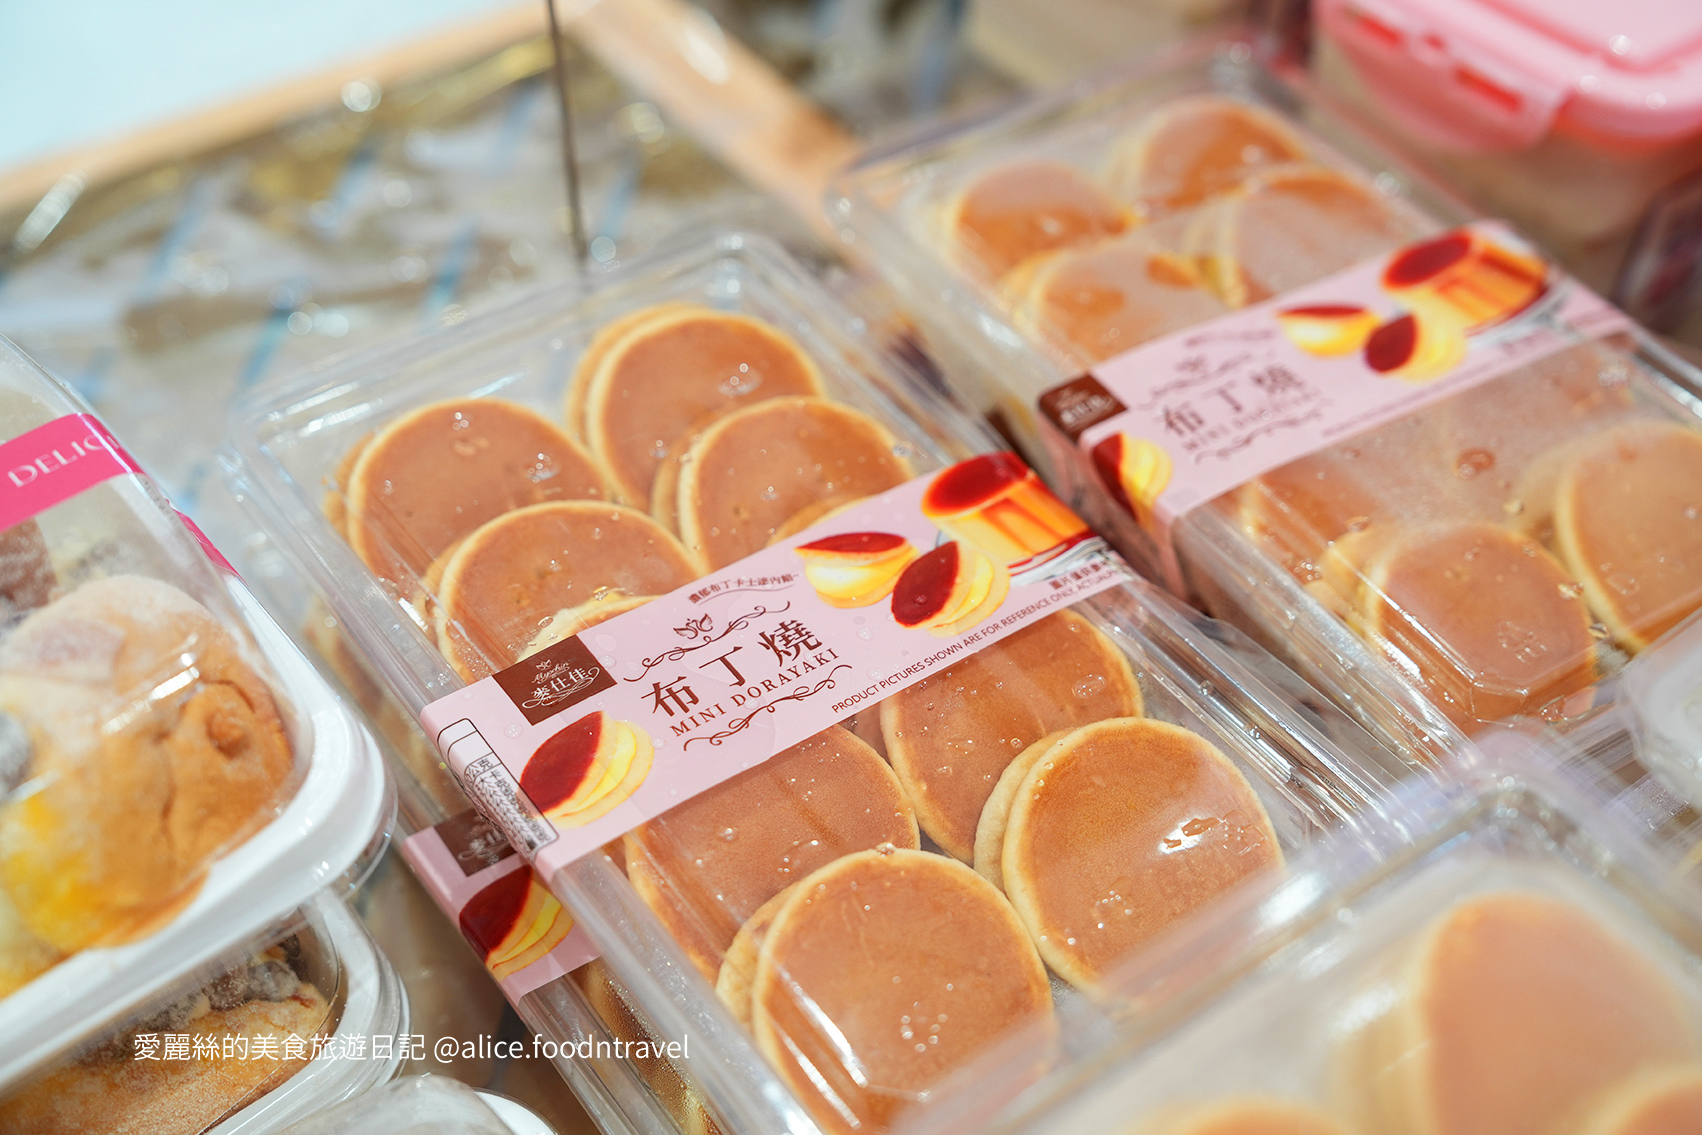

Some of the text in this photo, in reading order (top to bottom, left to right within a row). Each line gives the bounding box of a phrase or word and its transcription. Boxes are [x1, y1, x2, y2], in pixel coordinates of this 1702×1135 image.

[641, 619, 823, 717] 布丁燒
[669, 648, 840, 737] MINI DORAYAKI
[831, 684, 882, 713] PRODUCT
[879, 661, 926, 689] PICTURES
[924, 642, 964, 667] SHOWN
[963, 631, 983, 647] ARE
[981, 622, 1001, 637] FOR
[1000, 598, 1051, 627] REFERENCE
